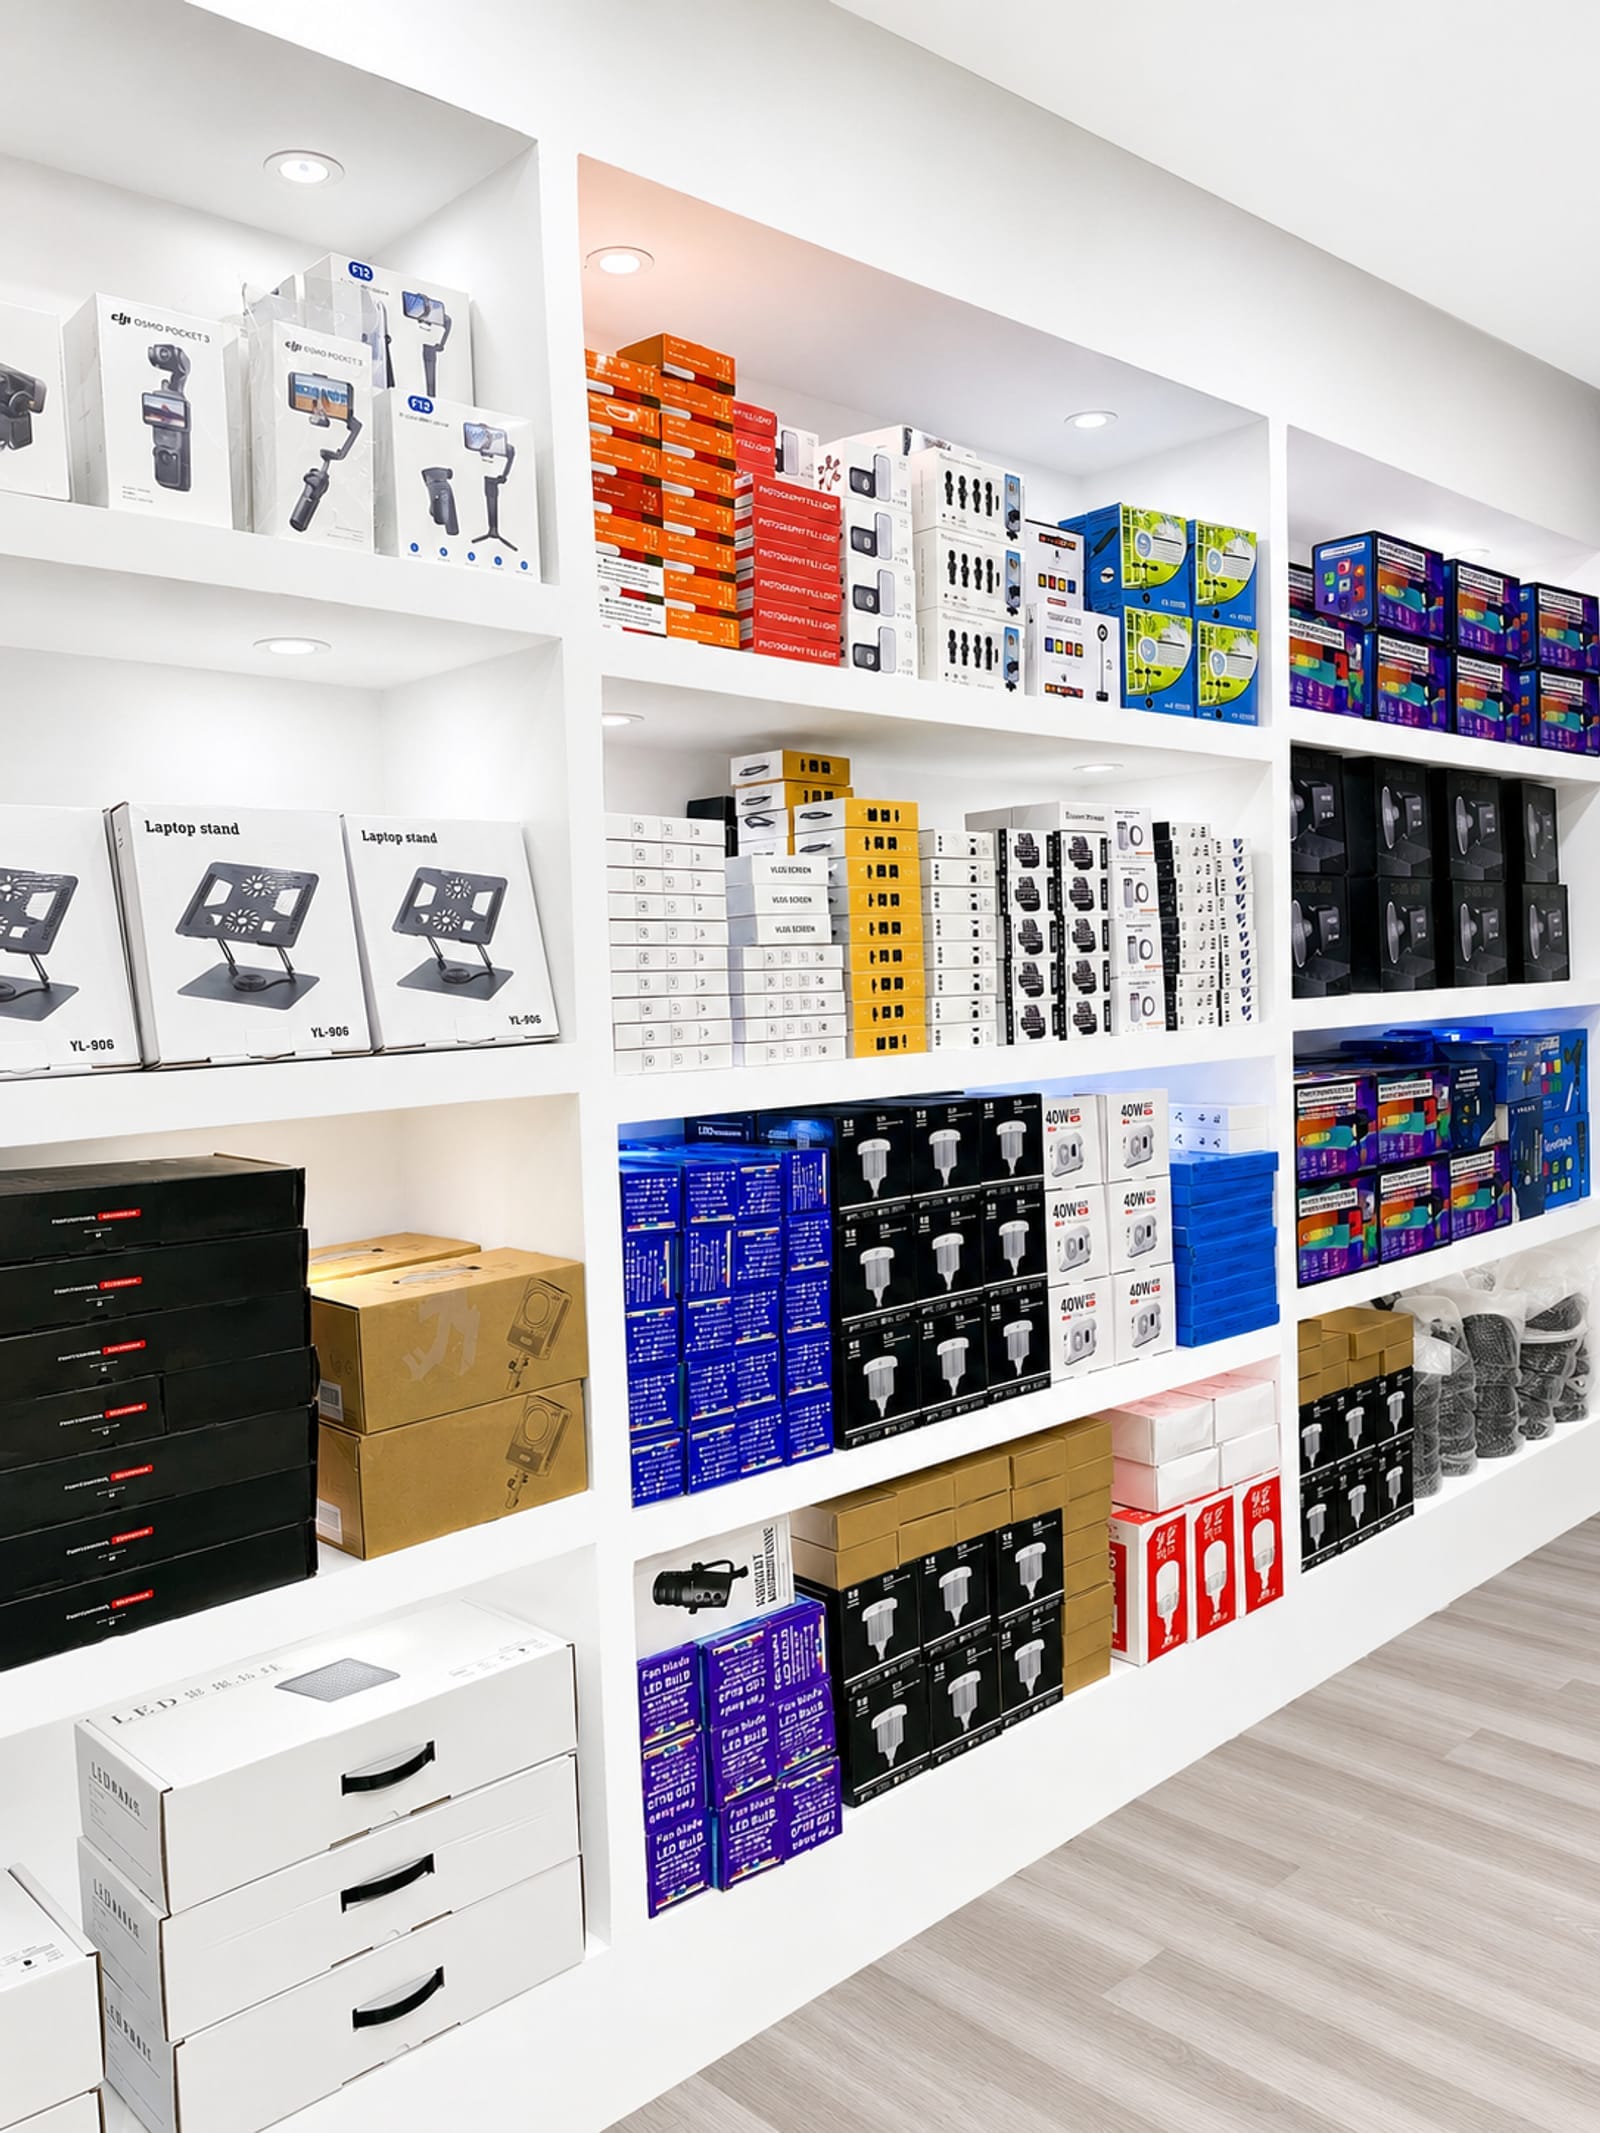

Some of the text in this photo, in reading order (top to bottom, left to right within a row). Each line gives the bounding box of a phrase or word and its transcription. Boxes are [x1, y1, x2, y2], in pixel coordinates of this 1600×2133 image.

[134, 319, 164, 331] OSMO
[165, 326, 202, 342] POCKET
[144, 820, 240, 837] Laptop stand
[361, 829, 438, 845] Laptop stand
[310, 1026, 350, 1038] YL-906
[69, 1038, 115, 1052] YL-906
[1045, 1109, 1069, 1124] 40W
[1121, 1103, 1143, 1117] 40W
[1124, 1192, 1146, 1207] 40W
[1052, 1202, 1077, 1219] 40W
[1060, 1295, 1084, 1312] 40W
[642, 1668, 661, 1681] Fan
[643, 1681, 662, 1696] LED
[656, 1843, 676, 1861] LED
